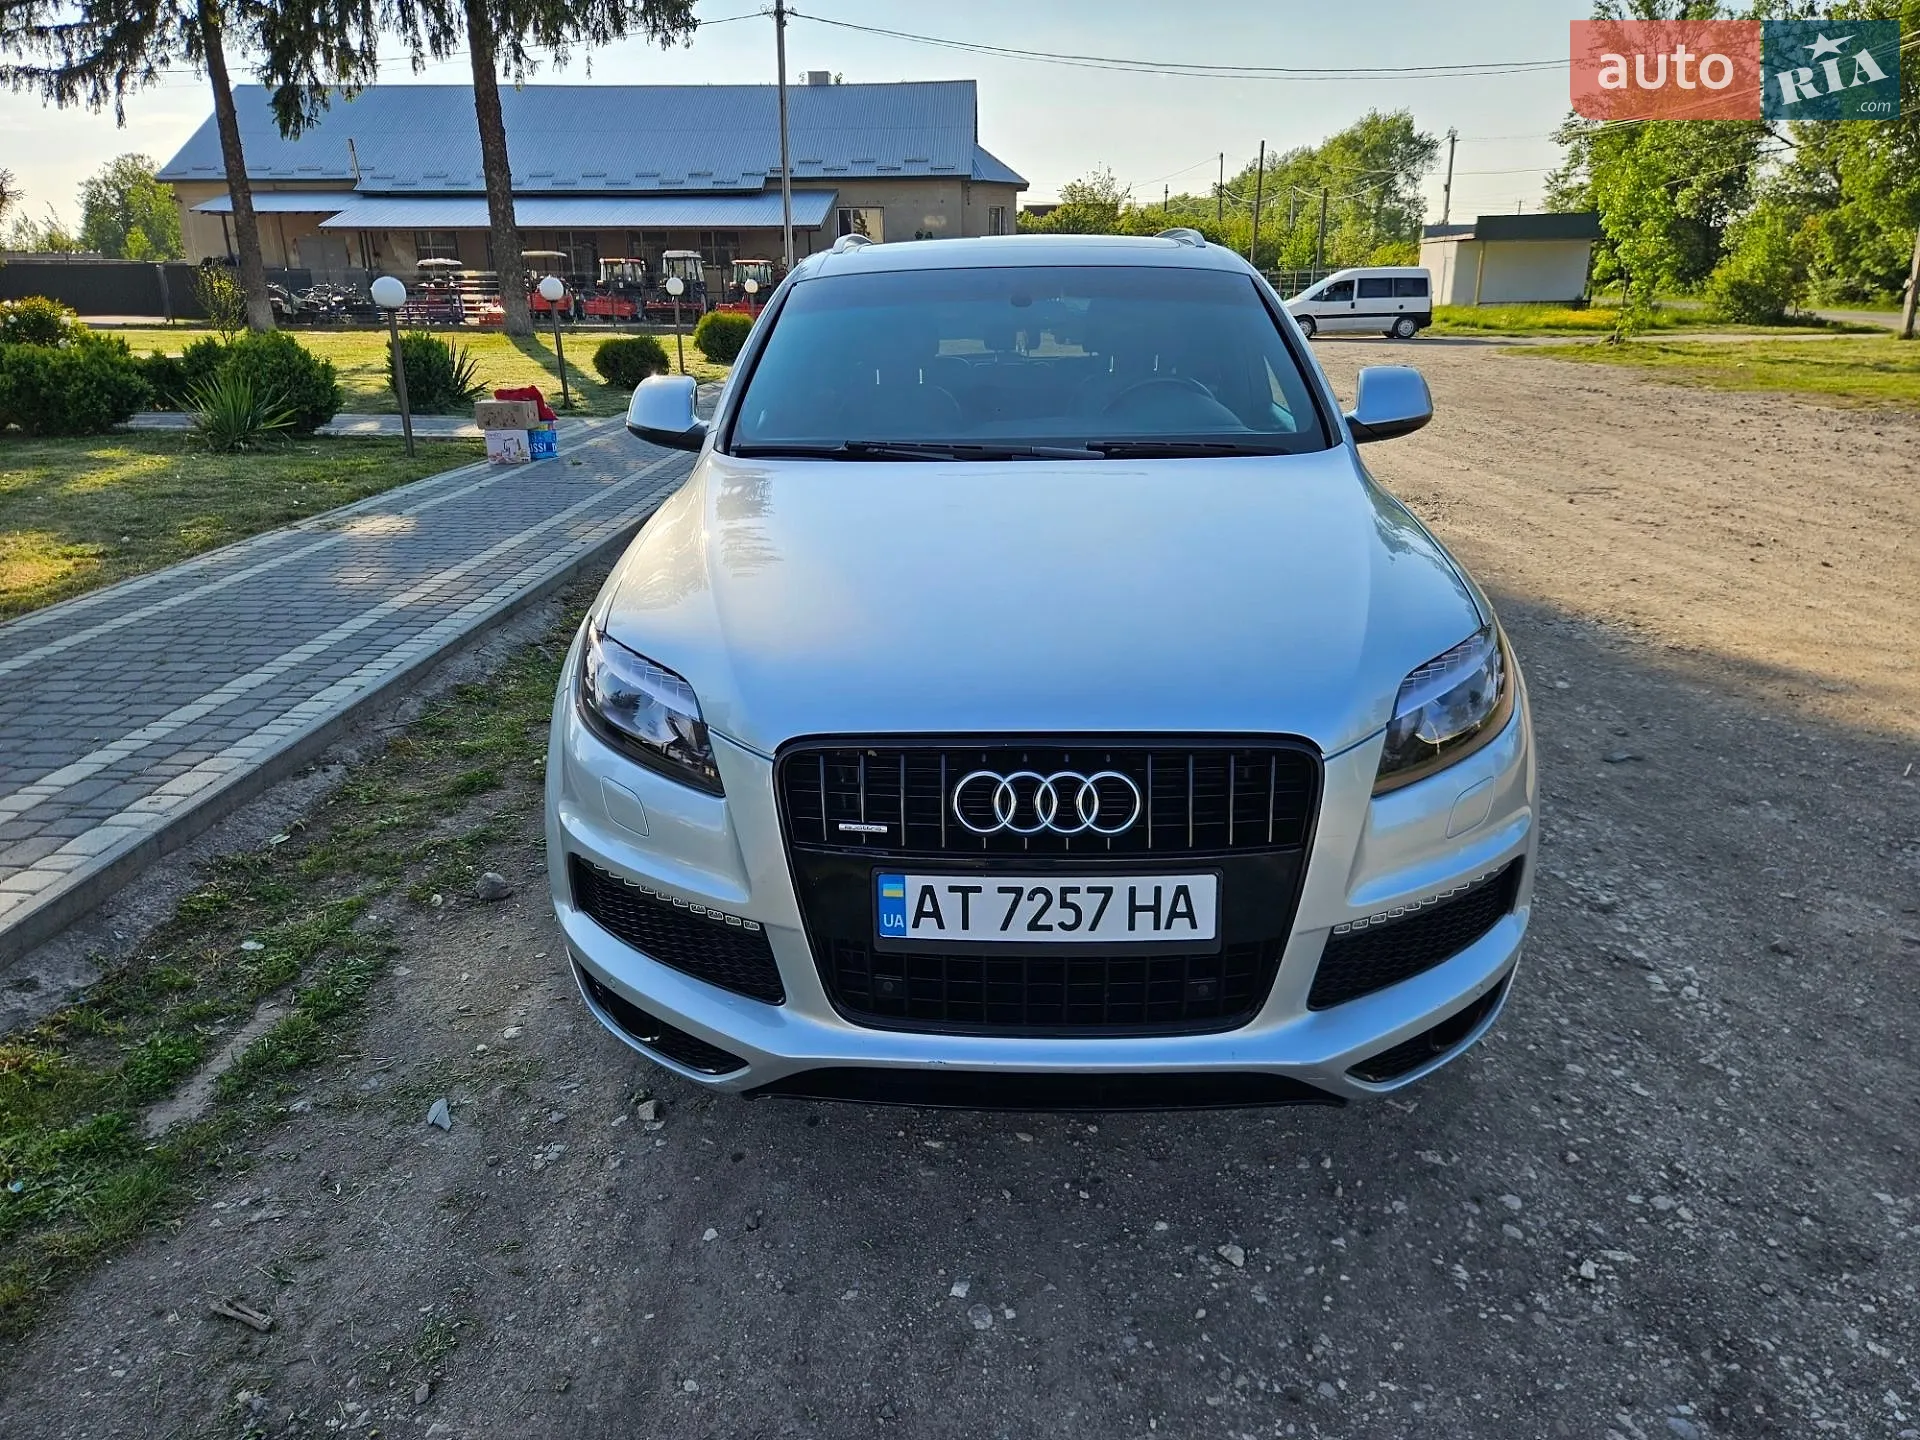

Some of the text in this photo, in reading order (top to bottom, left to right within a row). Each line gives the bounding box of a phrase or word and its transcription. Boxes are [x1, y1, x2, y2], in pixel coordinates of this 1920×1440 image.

[883, 914, 904, 928] UA
[911, 884, 1198, 931] AT 7257 HA
